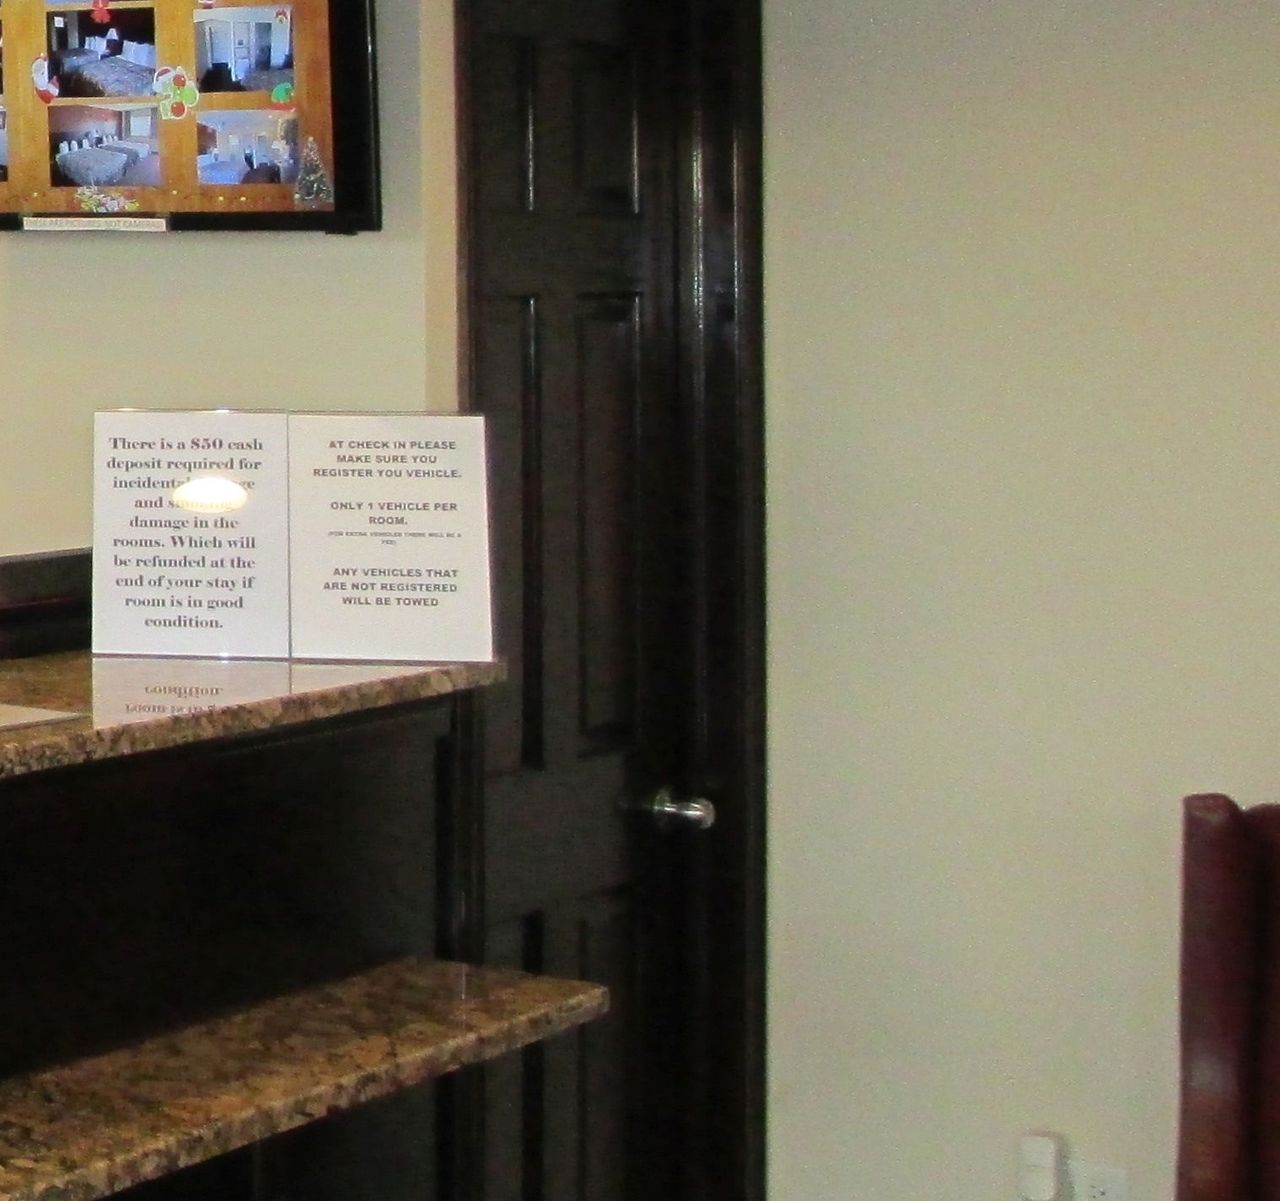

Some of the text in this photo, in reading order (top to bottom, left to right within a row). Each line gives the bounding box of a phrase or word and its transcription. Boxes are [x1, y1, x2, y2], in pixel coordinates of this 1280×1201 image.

[108, 437, 263, 451] There is a $50 cash
[329, 441, 456, 450] AT CHECK IN PLEASE
[107, 457, 262, 472] deposit required for
[336, 455, 437, 464] MAKE SURE YOU
[313, 468, 462, 478] REGISTER YOU VEHICLE.
[134, 496, 164, 509] and
[331, 502, 457, 511] ONLY 1 VEHICLE PER
[129, 516, 239, 529] damage in the
[369, 517, 408, 525] ROOM.
[113, 535, 256, 549] rooms. Which will
[114, 555, 256, 569] be refunded at the
[333, 568, 459, 578] ANY VEHICLES THAT
[116, 575, 256, 591] end of your stay if
[324, 582, 457, 592] ARE NOT REGISTERED
[125, 595, 243, 609] room is in good
[342, 597, 438, 607] WILL BE TOWED
[144, 616, 223, 629] condition.
